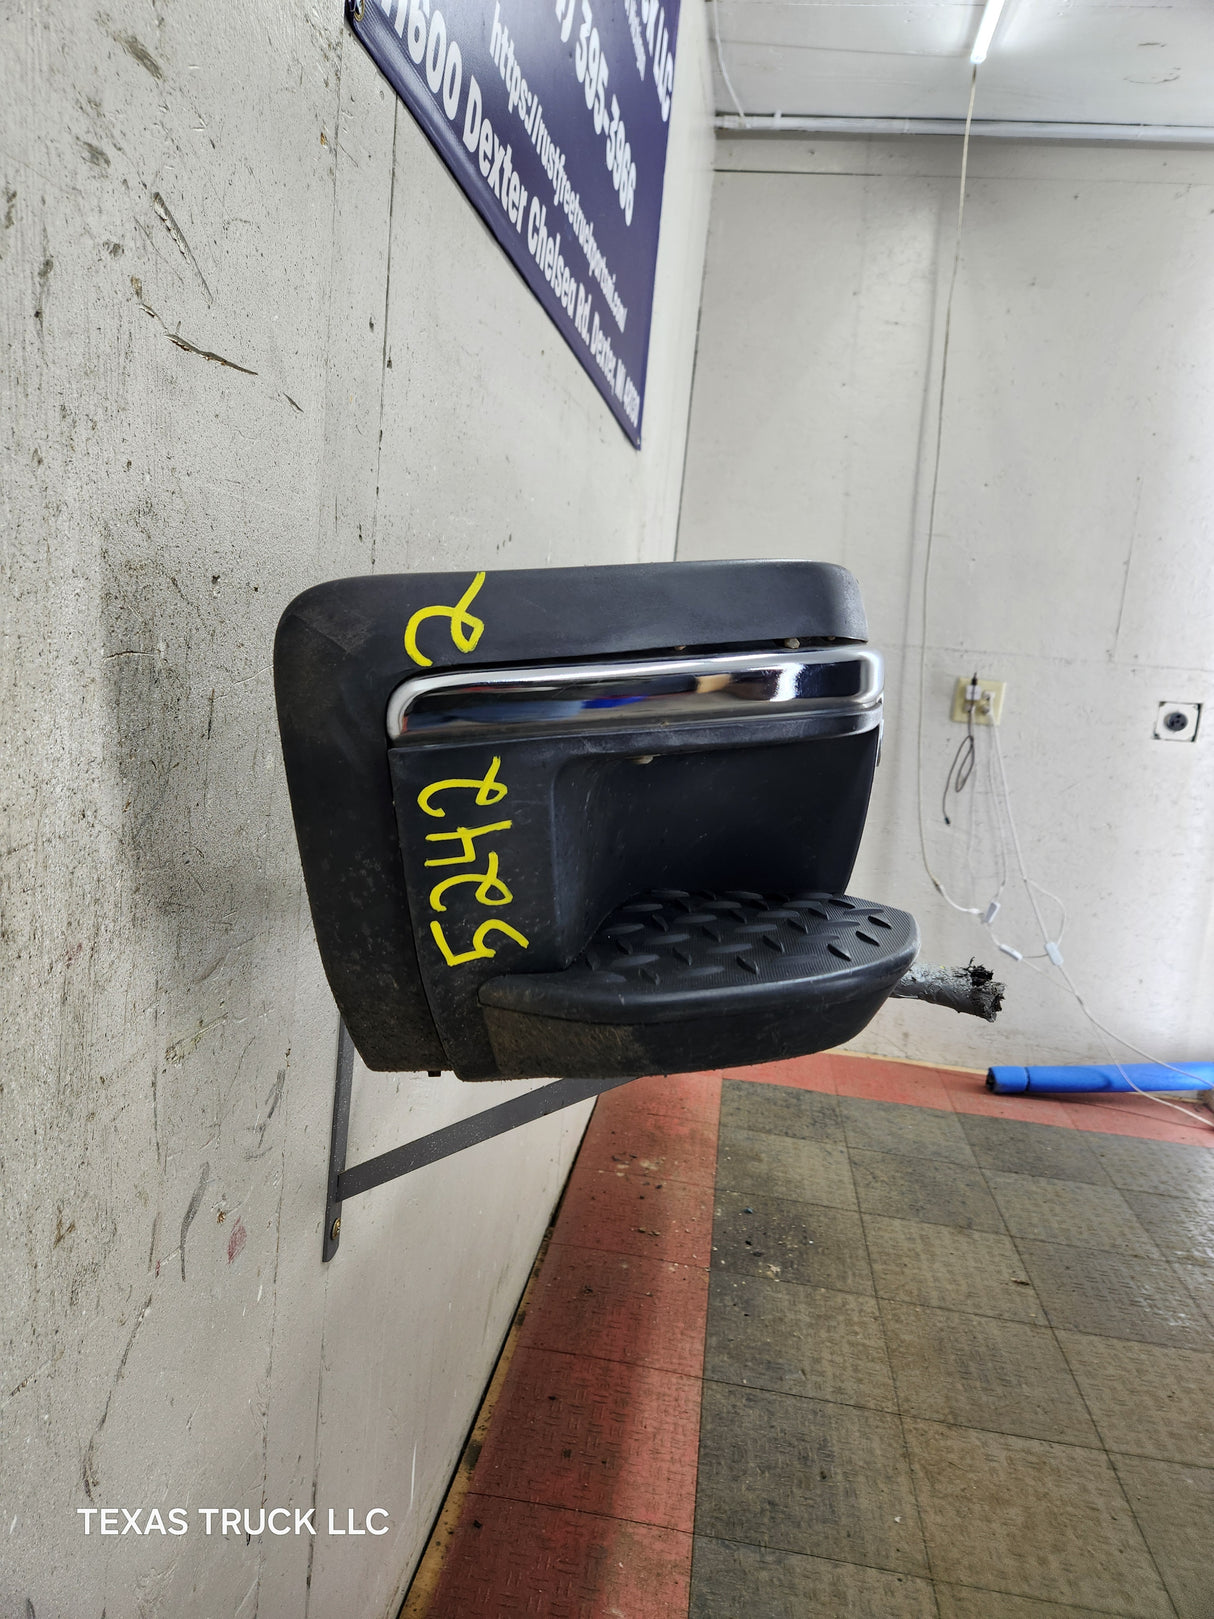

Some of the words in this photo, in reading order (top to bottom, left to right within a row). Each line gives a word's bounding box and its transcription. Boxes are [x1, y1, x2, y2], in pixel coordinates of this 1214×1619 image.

[463, 75, 527, 233] Dexter
[528, 196, 577, 319] Chelsea
[575, 283, 592, 346] Rd.
[575, 0, 636, 226] 395-3966
[418, 757, 529, 967] 5242
